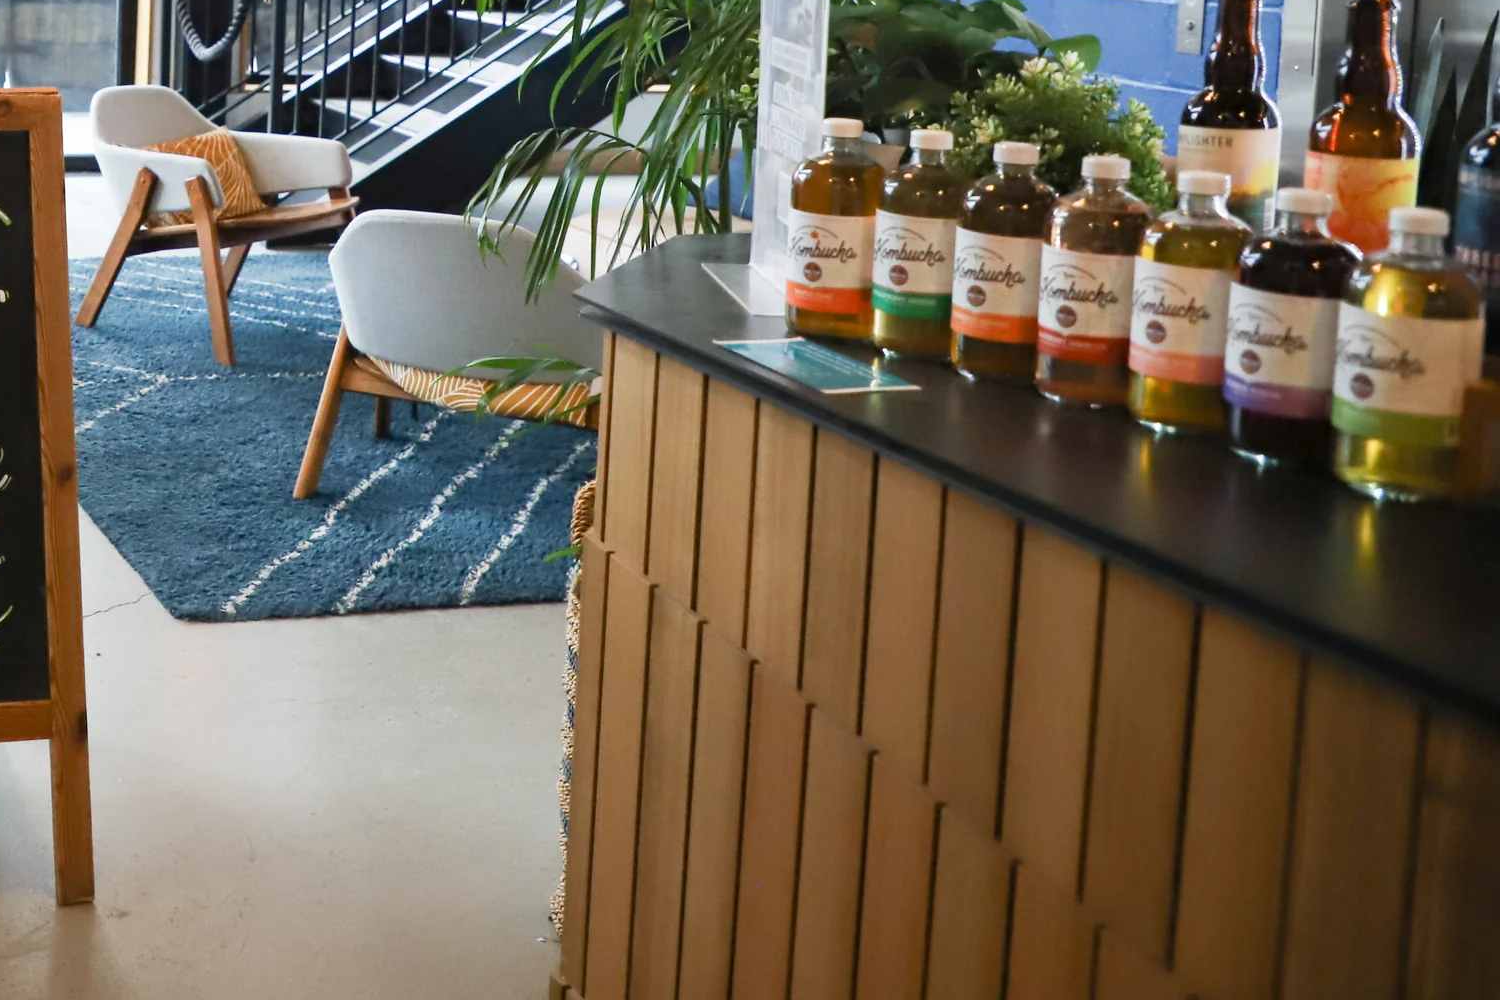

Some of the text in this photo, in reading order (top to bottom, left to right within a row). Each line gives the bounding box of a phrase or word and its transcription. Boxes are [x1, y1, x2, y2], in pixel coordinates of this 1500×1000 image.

[788, 236, 857, 264] Kombucha
[873, 238, 946, 267] Kombucha
[953, 257, 1026, 289] Kombucha
[1040, 276, 1119, 309] Kombucha
[1133, 289, 1211, 325] Kombucha
